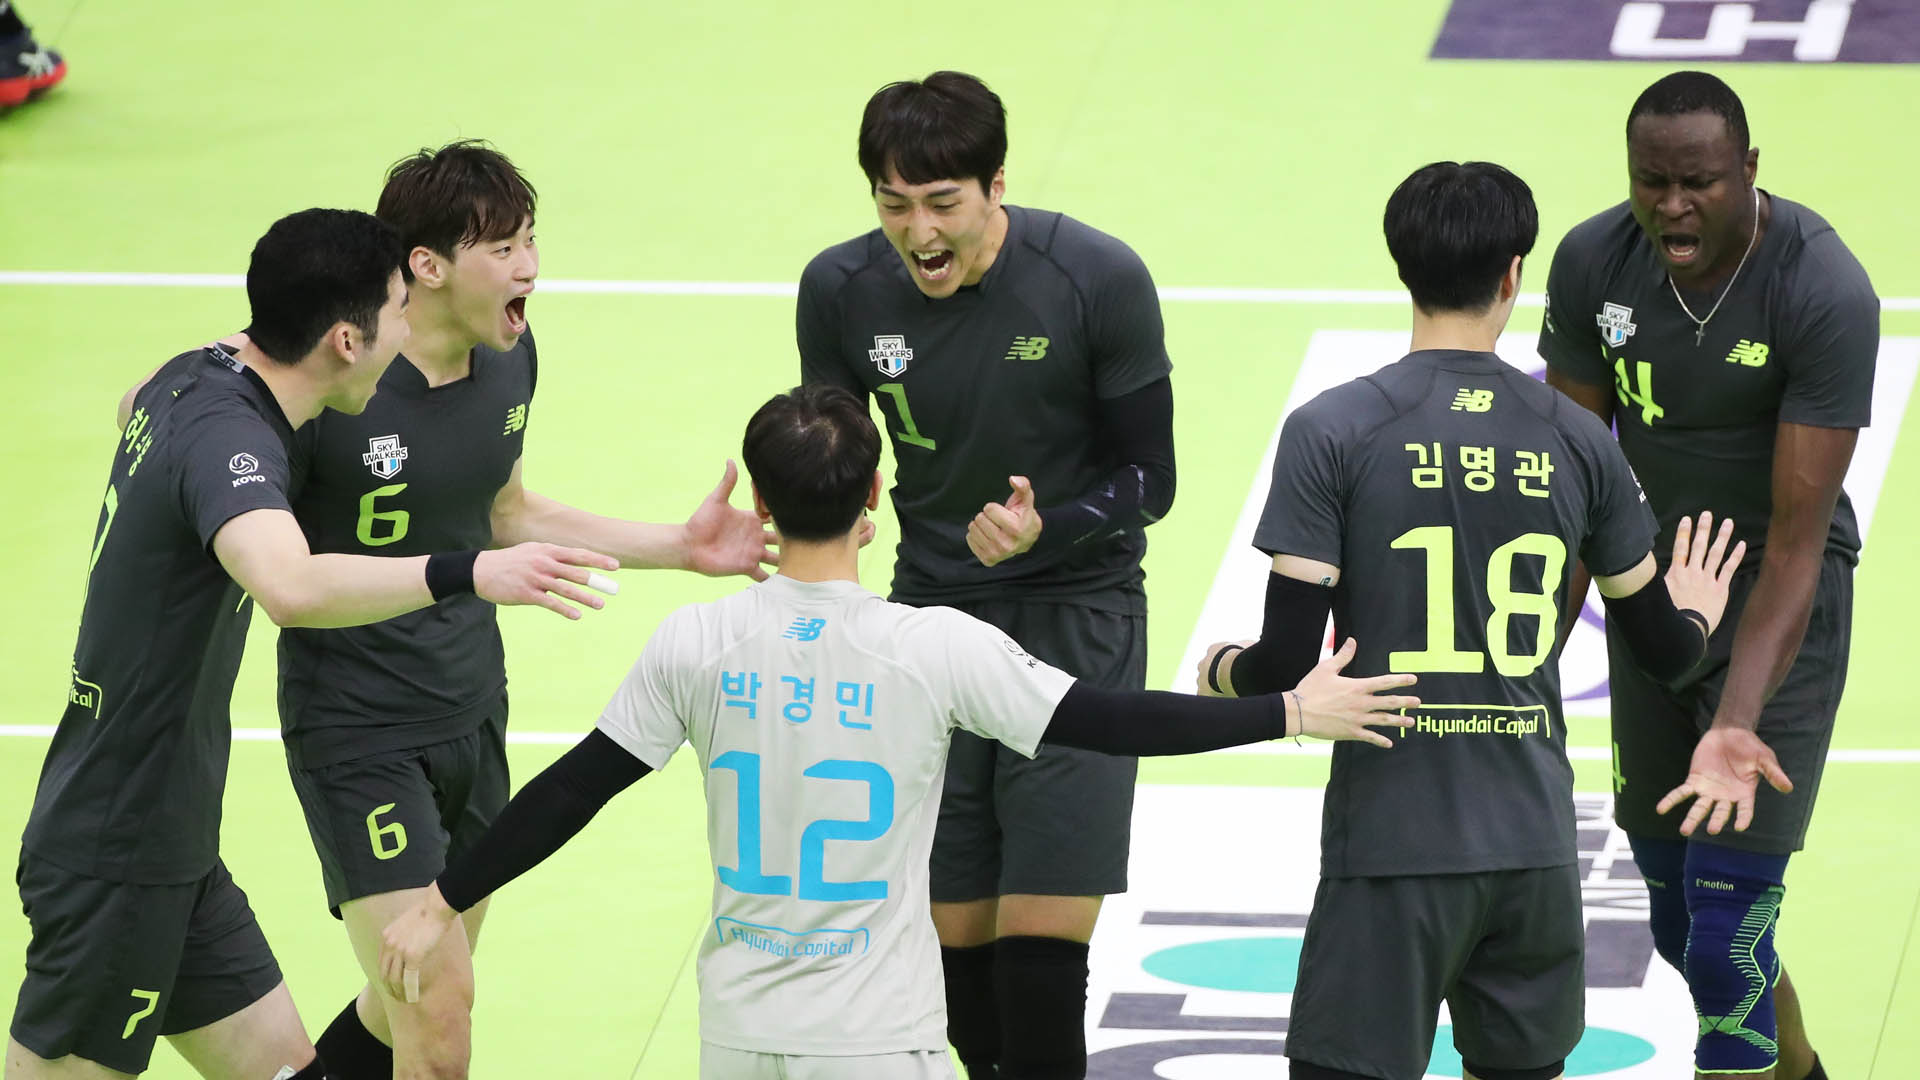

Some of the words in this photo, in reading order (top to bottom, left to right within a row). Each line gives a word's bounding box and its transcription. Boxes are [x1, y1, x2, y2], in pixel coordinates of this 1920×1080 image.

[869, 349, 912, 360] WALKERS
[882, 342, 899, 350] SKY
[877, 383, 936, 450] 1
[364, 448, 407, 464] WALKERS
[376, 442, 394, 452] SKY
[1404, 442, 1555, 498] 김명관
[232, 474, 266, 488] KOVO
[356, 482, 410, 547] 6
[1388, 525, 1567, 678] 18
[721, 670, 875, 731] 박경민
[1416, 715, 1491, 739] Hyundai
[1493, 715, 1539, 739] Capal
[366, 802, 408, 860] 6
[709, 750, 895, 902] 12
[730, 927, 790, 958] Hyundai
[793, 936, 855, 957] Capital
[121, 988, 161, 1040] 7
